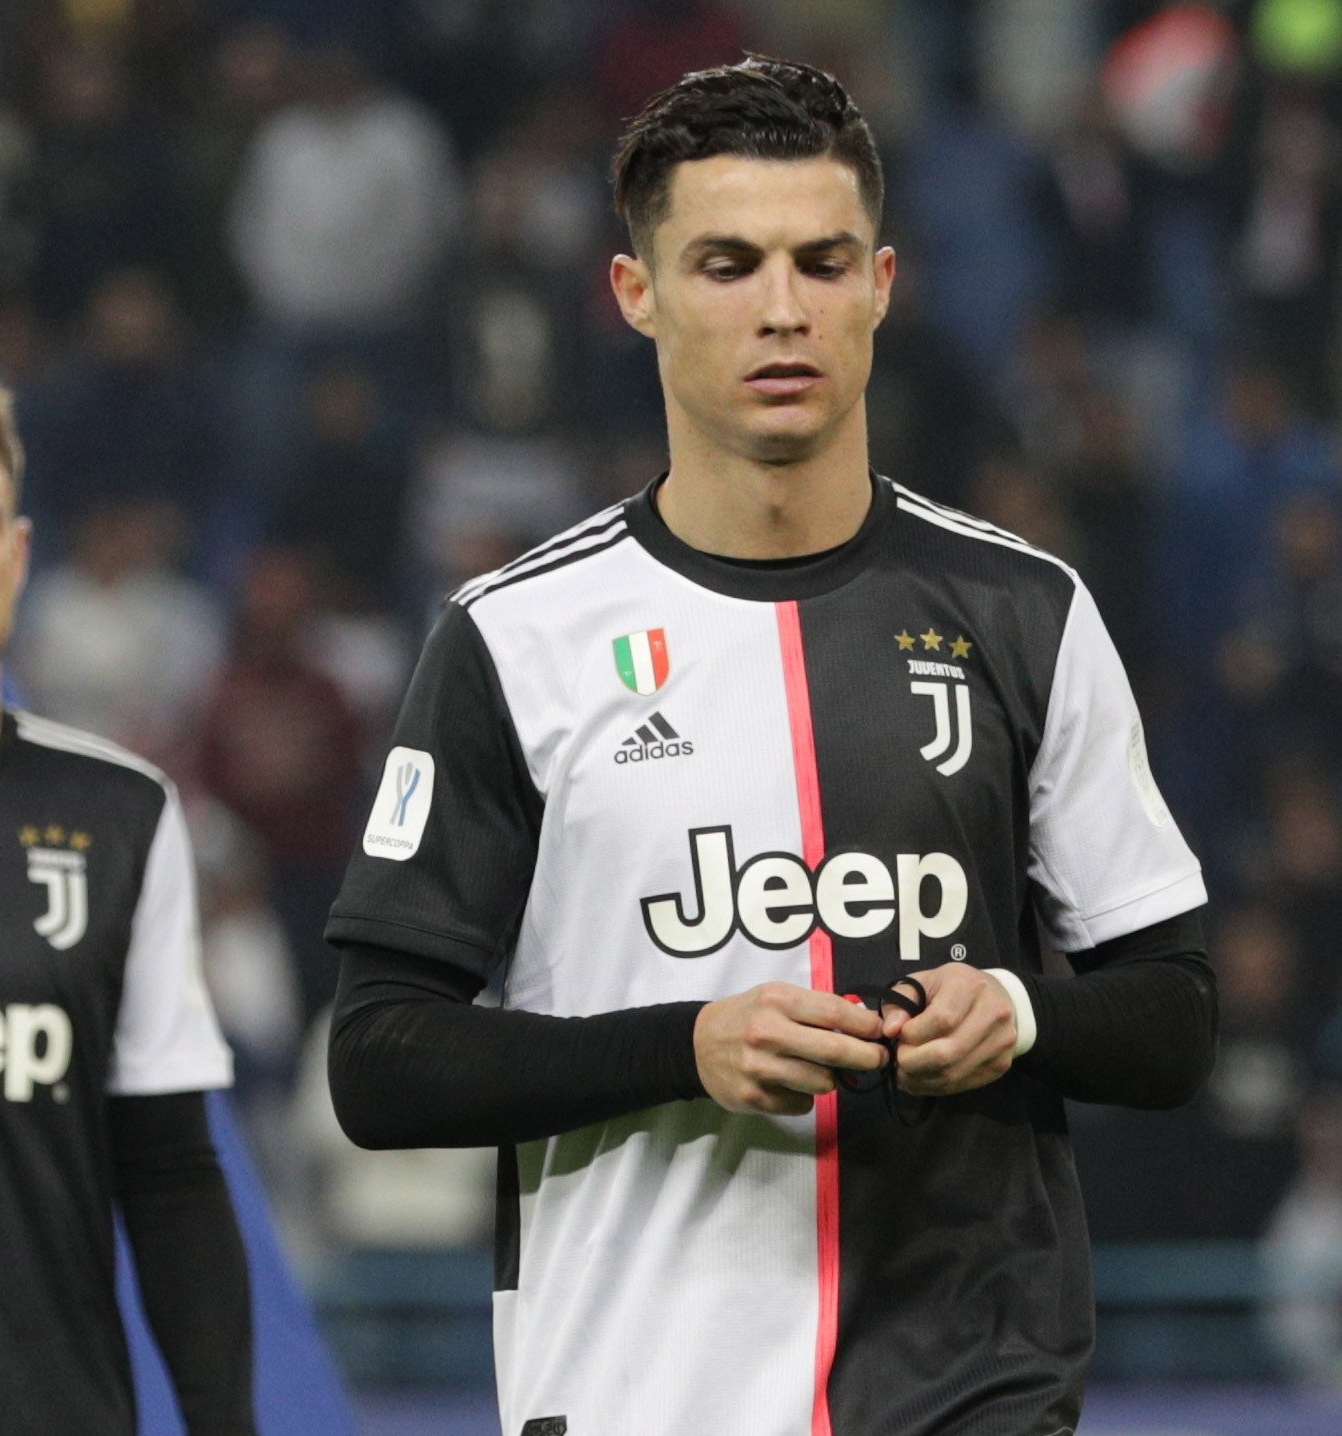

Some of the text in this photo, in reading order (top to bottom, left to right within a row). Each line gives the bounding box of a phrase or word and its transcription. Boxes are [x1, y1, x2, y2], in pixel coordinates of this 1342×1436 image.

[907, 659, 966, 680] JUVENTUS
[614, 741, 694, 765] adidas
[367, 834, 414, 851] SUPERCOPPA
[640, 824, 970, 961] Jeep
